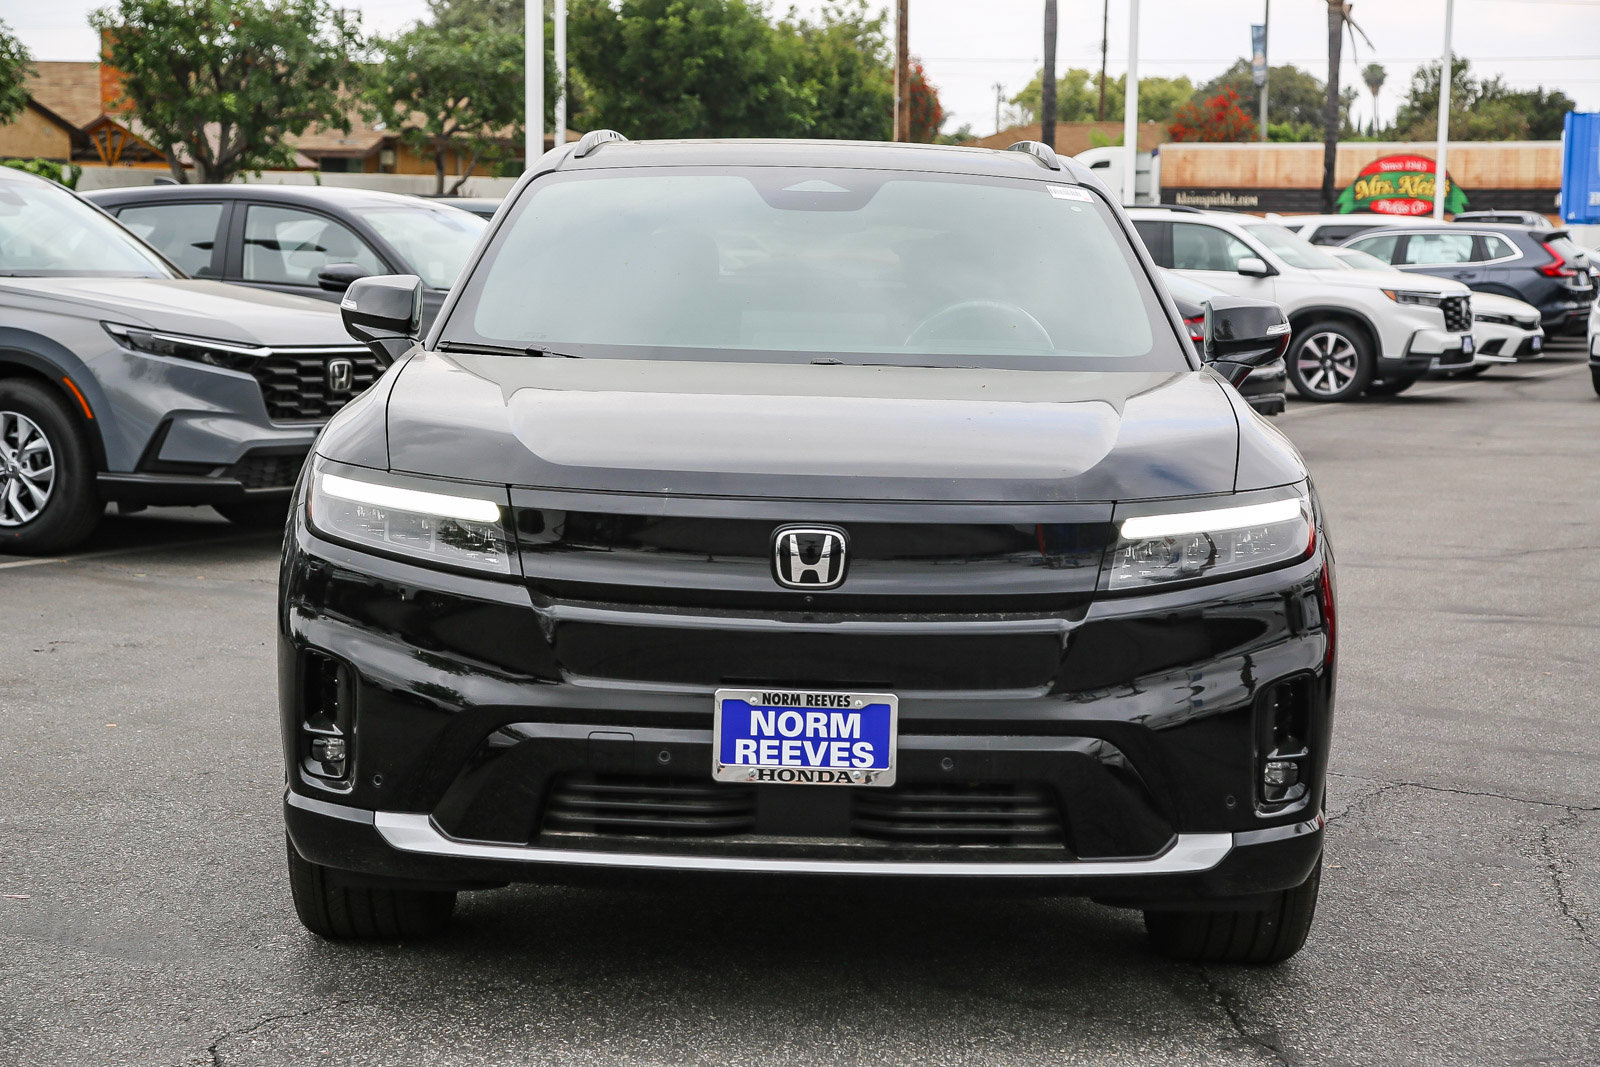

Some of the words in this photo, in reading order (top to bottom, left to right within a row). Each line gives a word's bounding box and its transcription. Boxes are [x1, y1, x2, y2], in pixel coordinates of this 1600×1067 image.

[762, 692, 801, 706] NORM
[806, 694, 851, 708] REEVES
[750, 710, 861, 739] NORM
[735, 738, 875, 768] REEVES
[756, 768, 855, 784] HONDA
